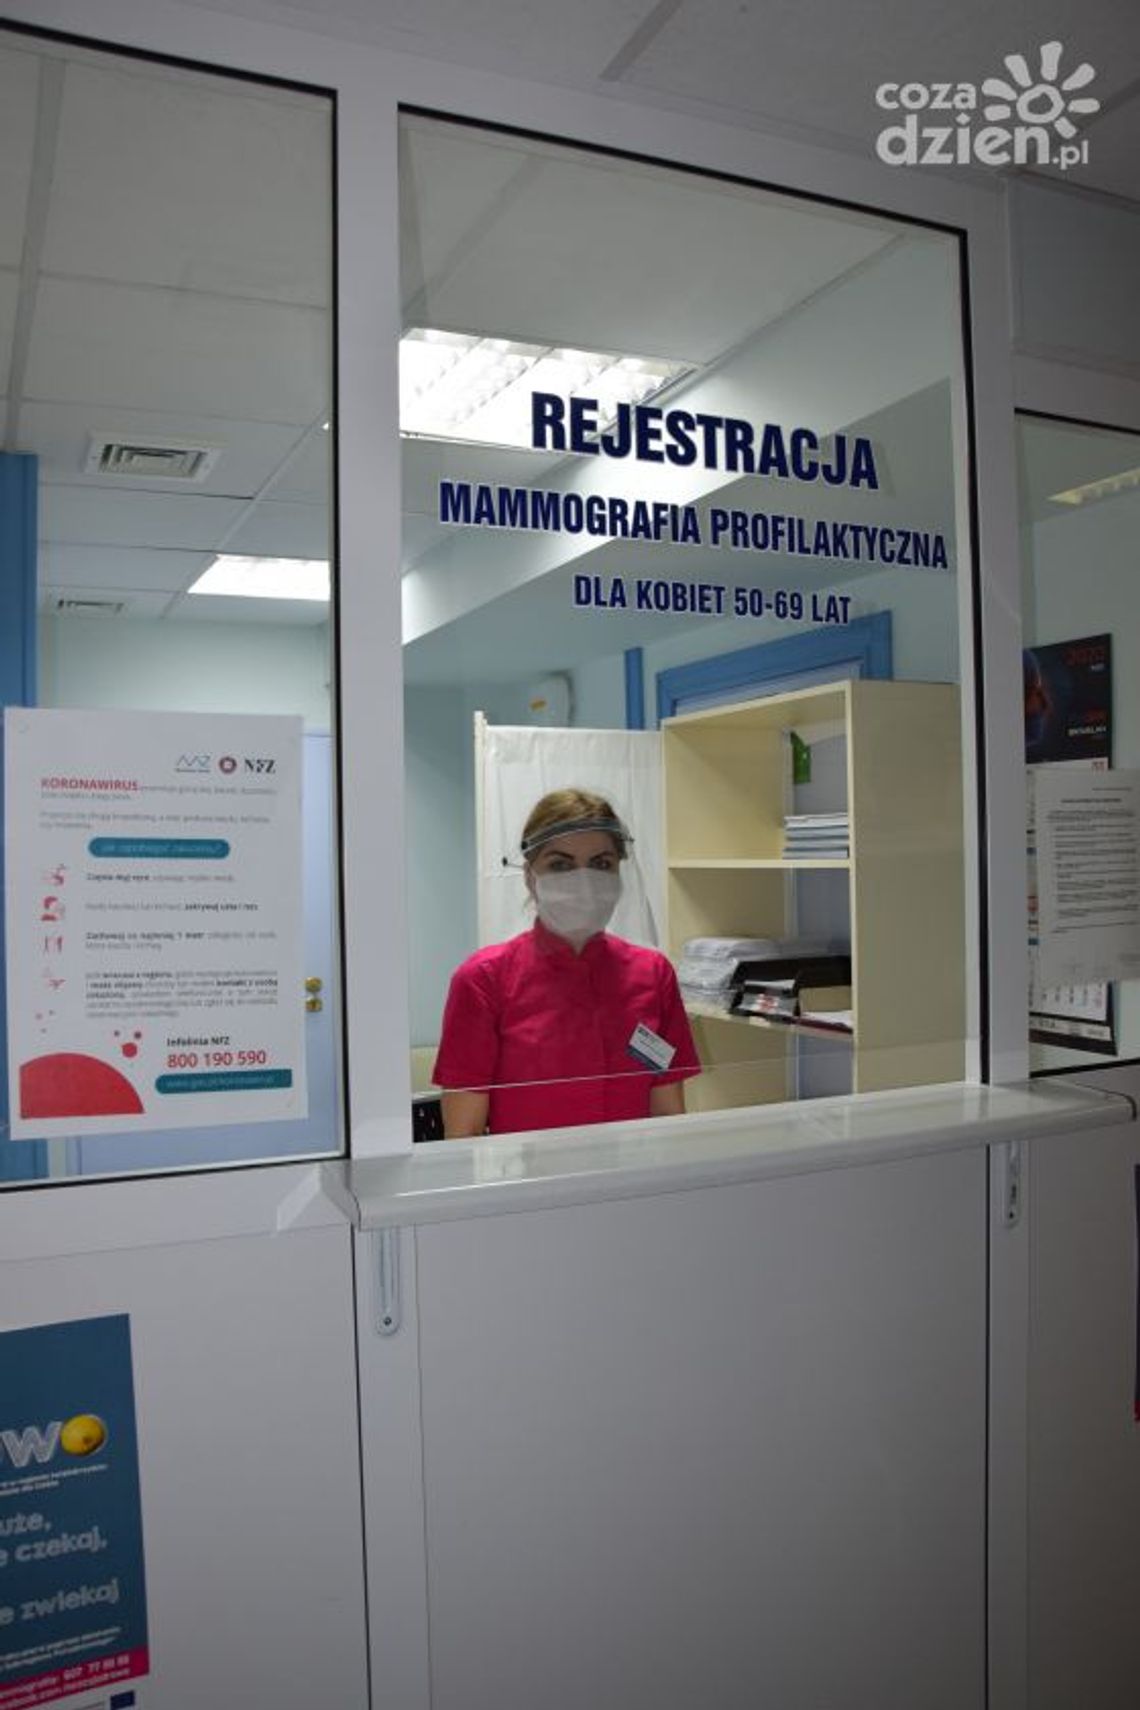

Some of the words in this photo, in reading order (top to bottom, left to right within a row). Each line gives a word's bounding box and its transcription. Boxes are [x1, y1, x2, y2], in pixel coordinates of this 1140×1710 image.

[531, 391, 879, 489] REJESTRACJA
[439, 481, 700, 544] MAMMOGRAFIA
[711, 508, 948, 569] PROFILAKTYCZNA
[574, 575, 627, 609] DLA
[636, 580, 725, 614] KOBIET
[735, 587, 802, 620] 50-69
[812, 594, 851, 624] LAT
[243, 758, 276, 774] NFZ
[41, 777, 138, 792] KORONAWIRUS
[212, 1035, 230, 1046] NFZ
[167, 1053, 199, 1069] 800
[204, 1051, 233, 1067] 190
[238, 1050, 267, 1066] 590
[0, 1512, 51, 1537] uże,
